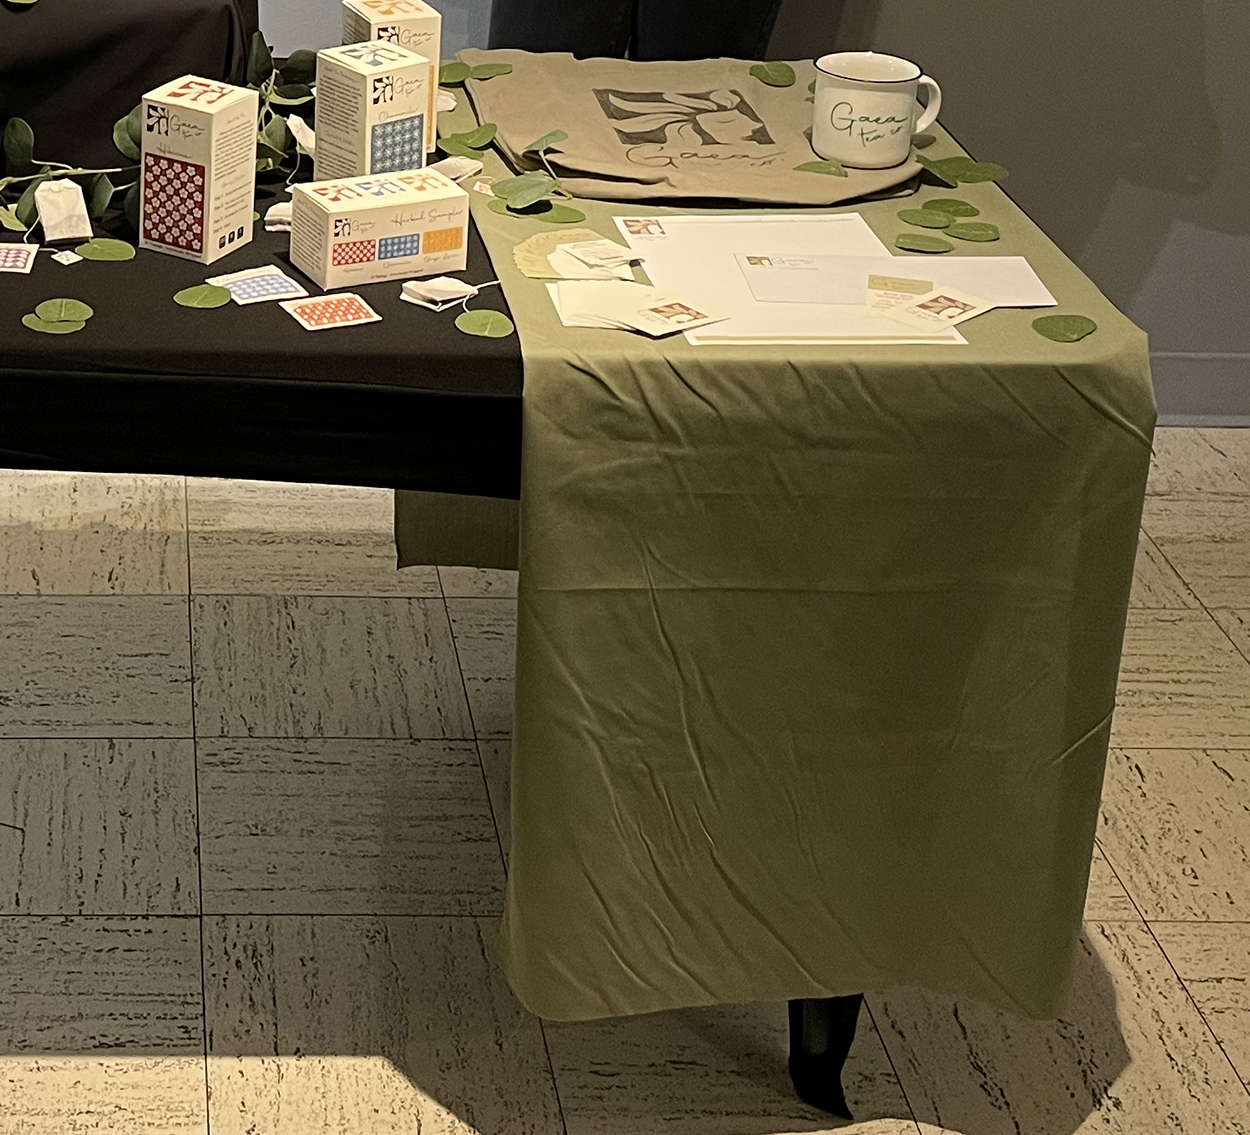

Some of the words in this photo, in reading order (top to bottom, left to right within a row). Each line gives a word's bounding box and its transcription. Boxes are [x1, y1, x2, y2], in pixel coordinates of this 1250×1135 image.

[830, 101, 908, 137] Gaea
[857, 127, 886, 147] tea
[626, 145, 787, 169] Gaea
